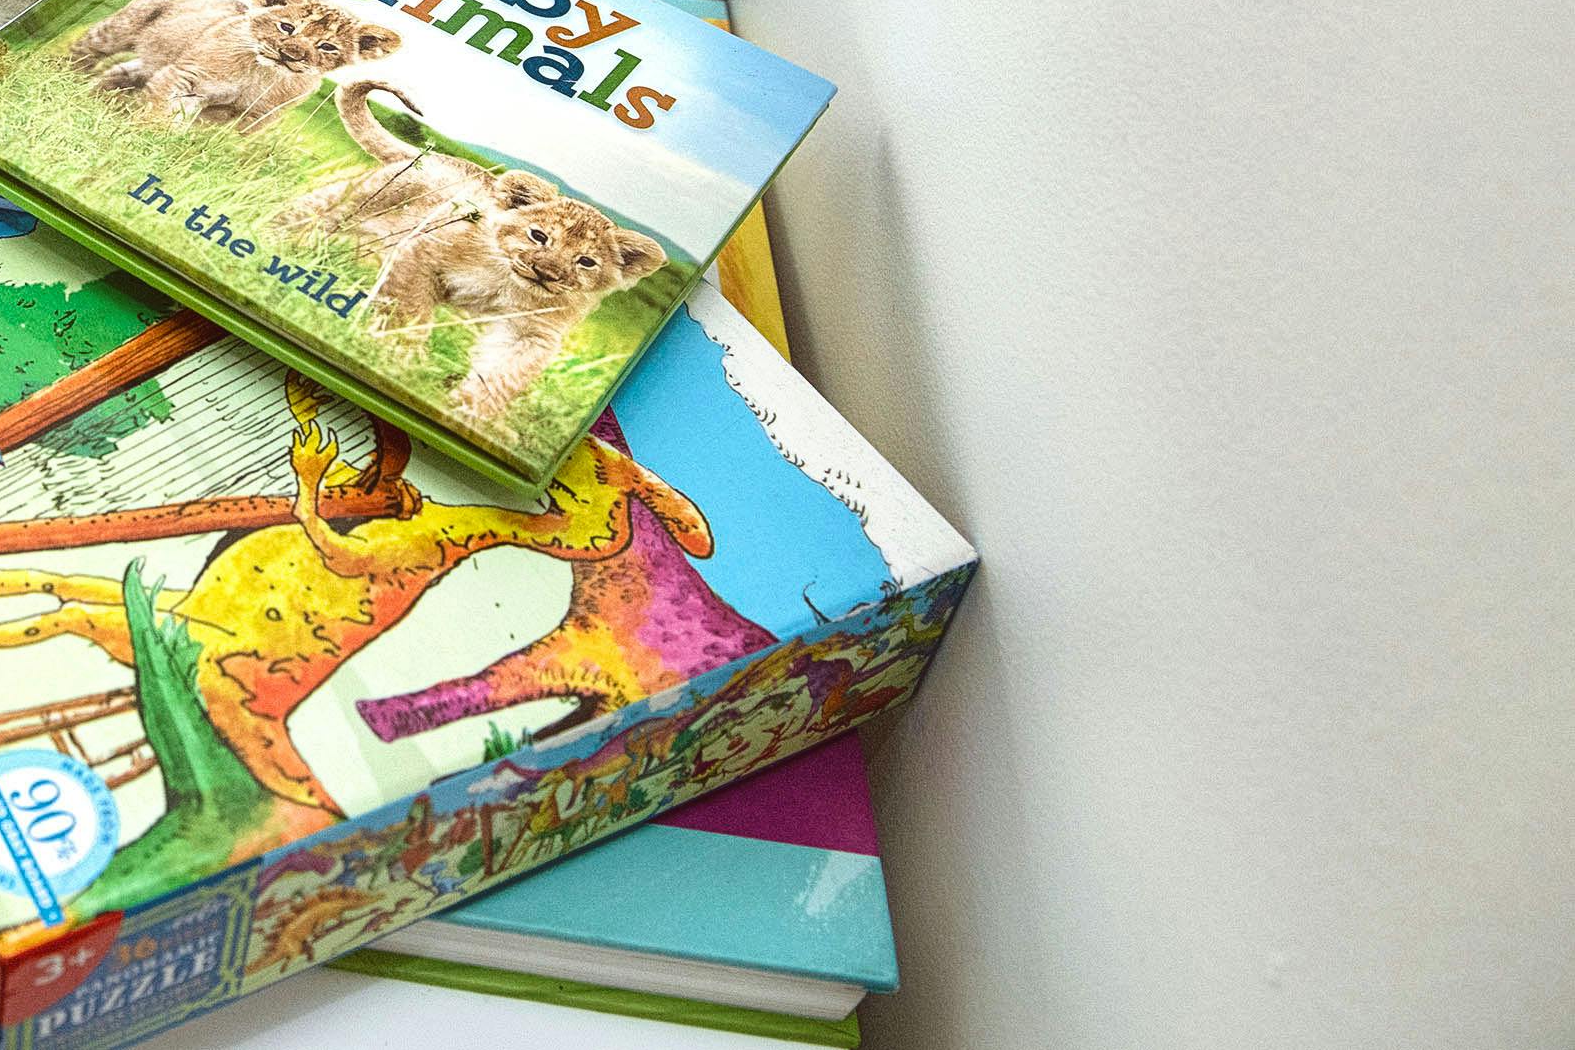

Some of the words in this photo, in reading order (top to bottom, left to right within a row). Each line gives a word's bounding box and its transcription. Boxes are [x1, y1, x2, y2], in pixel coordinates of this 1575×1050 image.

[127, 173, 174, 214] In
[184, 204, 256, 258] the
[263, 255, 368, 319] wild
[33, 948, 97, 987] 3+
[37, 948, 218, 1037] PUZZLE
